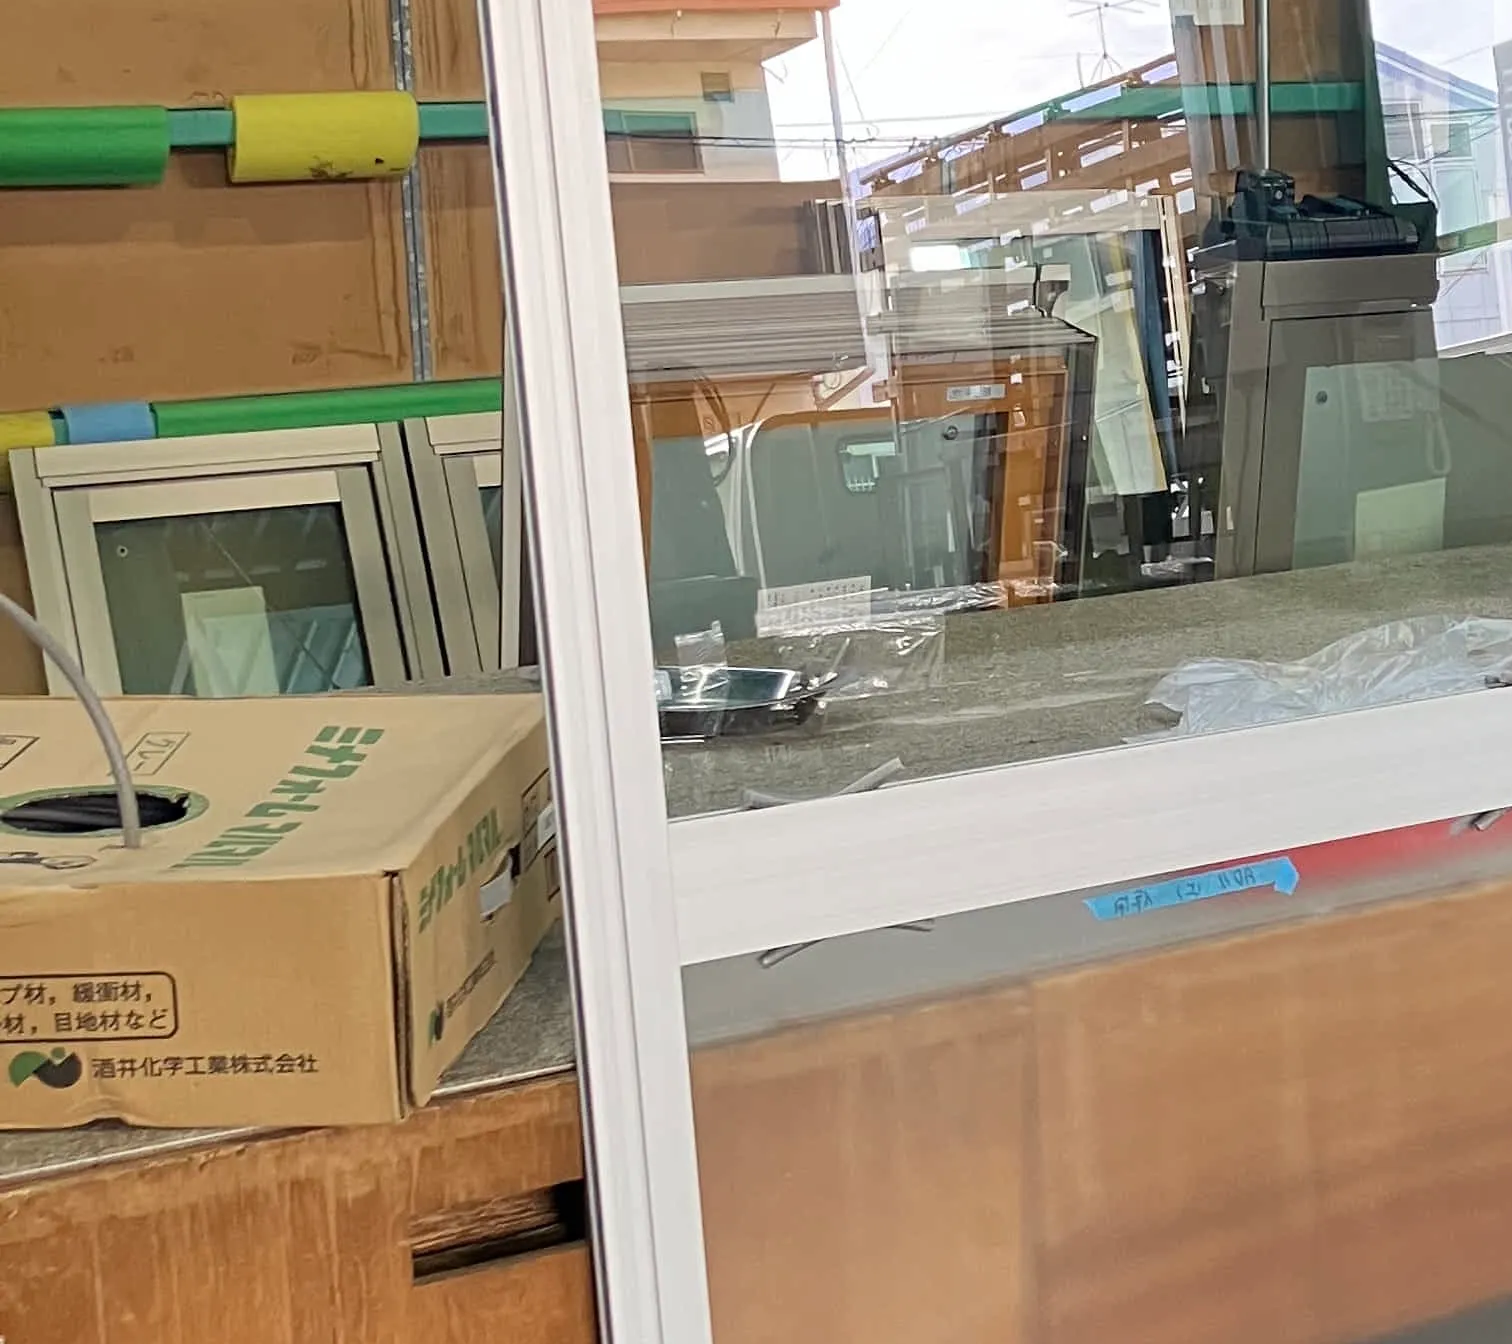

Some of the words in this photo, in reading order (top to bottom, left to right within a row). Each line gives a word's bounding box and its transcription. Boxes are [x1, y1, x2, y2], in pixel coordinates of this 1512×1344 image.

[0, 1008, 168, 1035] 材，目地材など
[91, 1053, 319, 1079] 酒井化学工業株式会社
